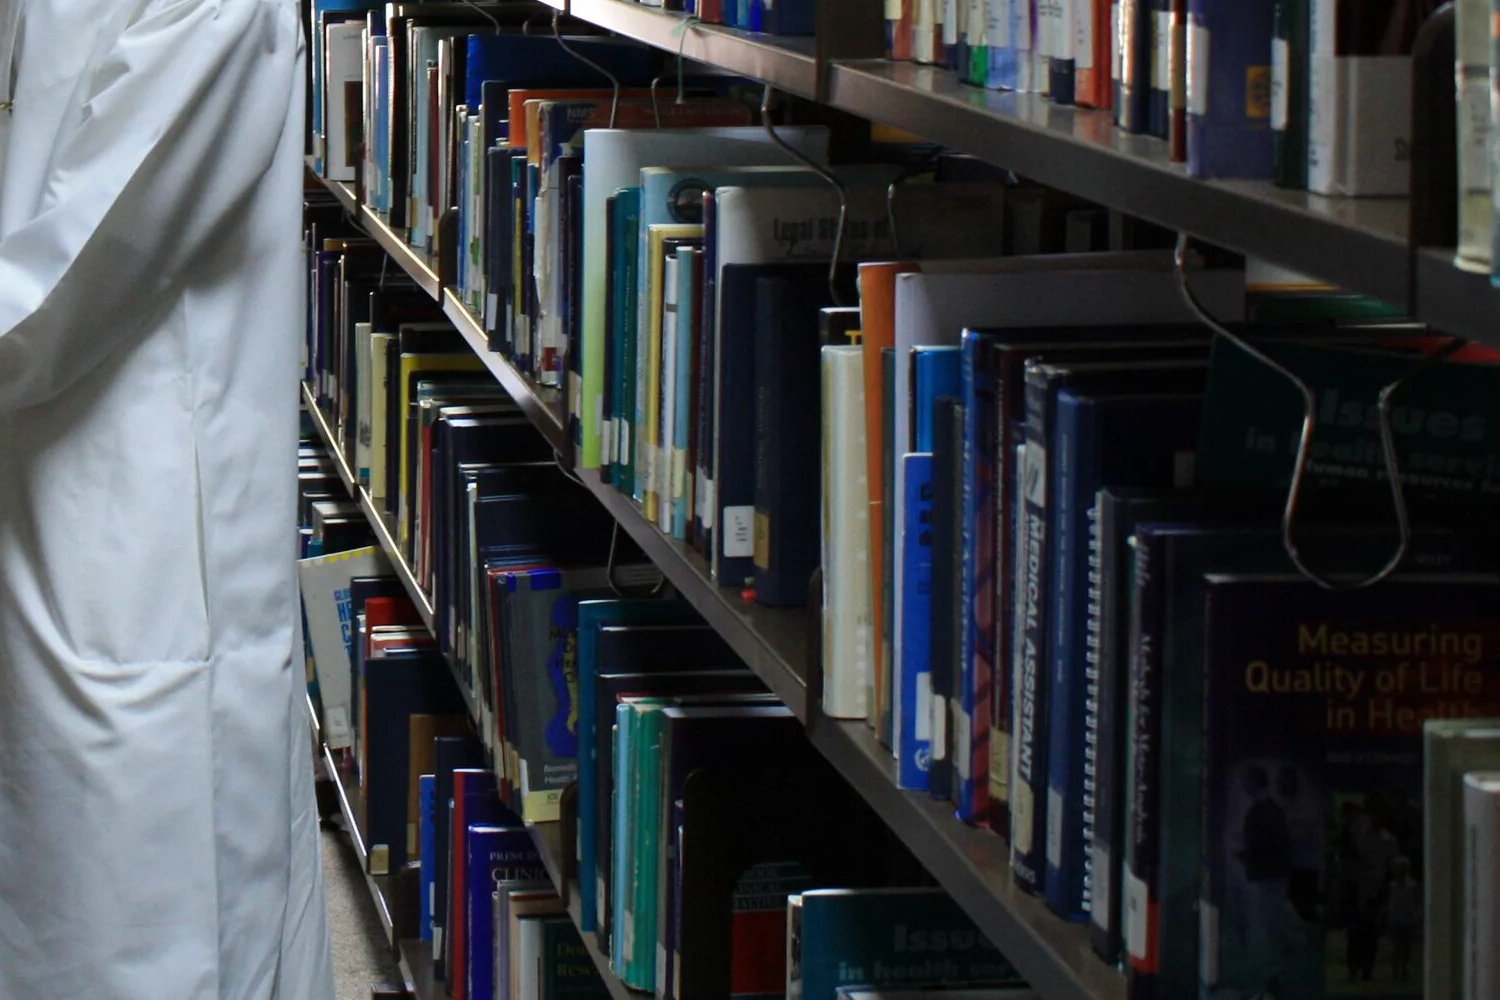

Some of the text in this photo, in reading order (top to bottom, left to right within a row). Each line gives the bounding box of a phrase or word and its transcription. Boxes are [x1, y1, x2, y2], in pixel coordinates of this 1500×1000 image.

[774, 218, 813, 245] Legal
[1019, 513, 1042, 783] MEDICAL ASSISTANT
[1298, 621, 1484, 665] Measuring
[1243, 658, 1484, 700] Quality of Life
[1327, 699, 1356, 730] in
[837, 961, 865, 982] in
